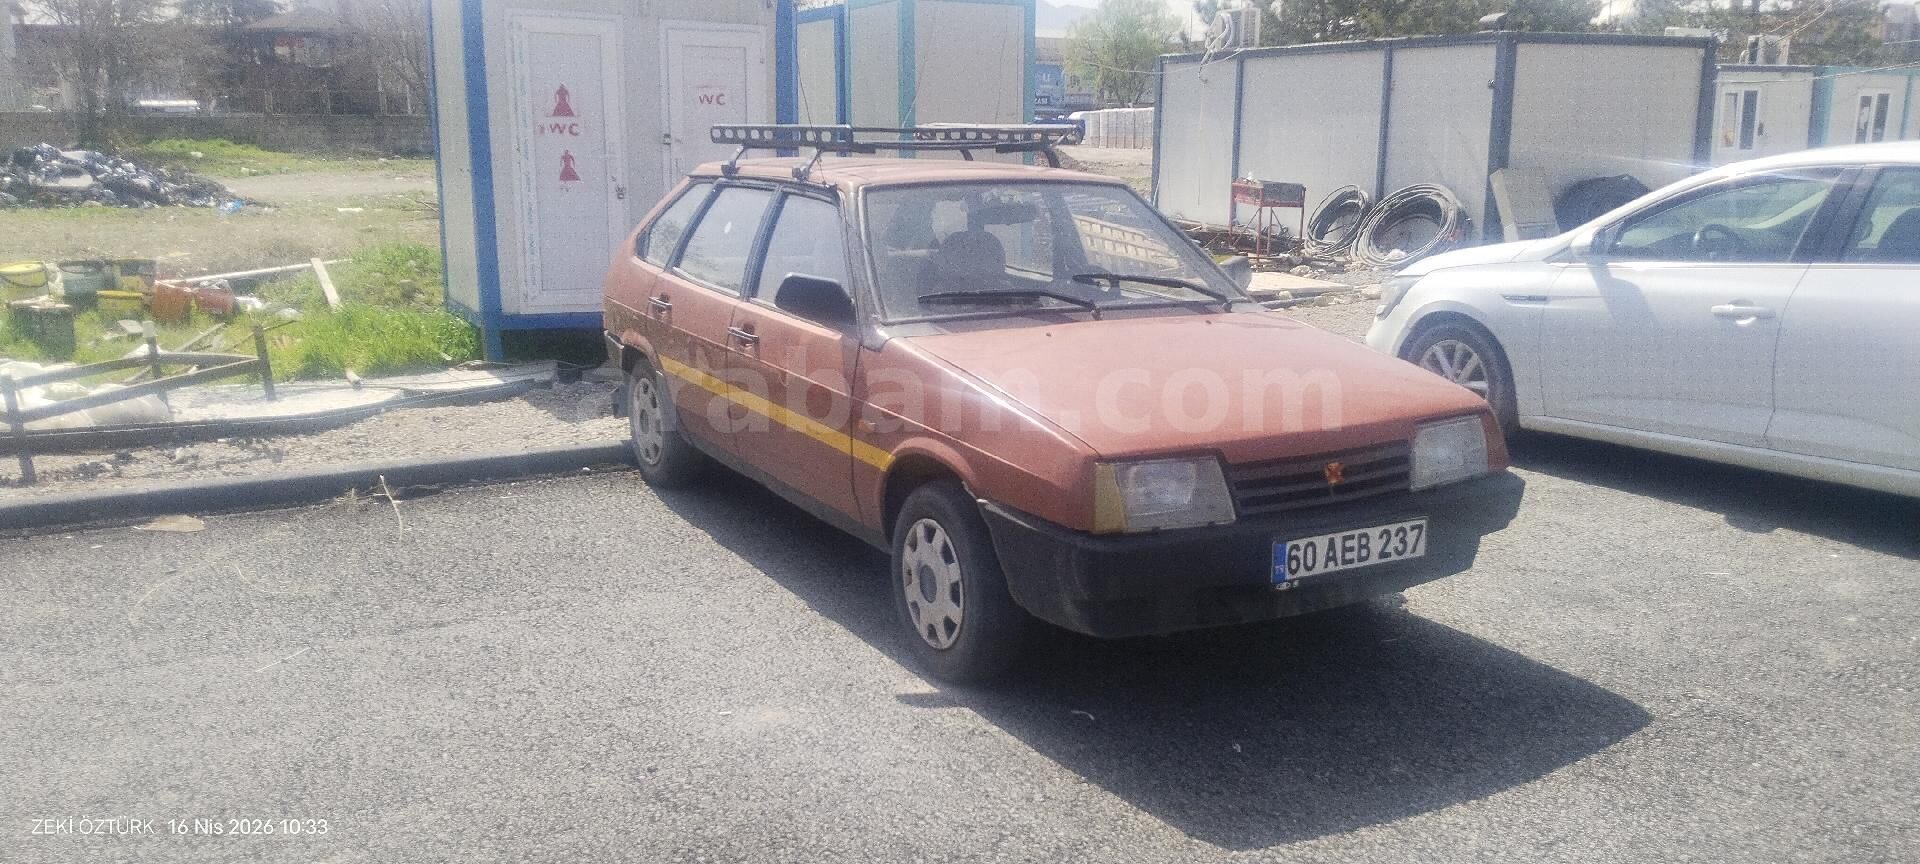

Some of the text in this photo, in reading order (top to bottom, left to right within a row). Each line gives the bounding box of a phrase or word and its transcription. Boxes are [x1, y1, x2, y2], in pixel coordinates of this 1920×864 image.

[698, 93, 726, 106] WC
[549, 122, 580, 137] WC
[1287, 523, 1424, 576] 60 AEB 237
